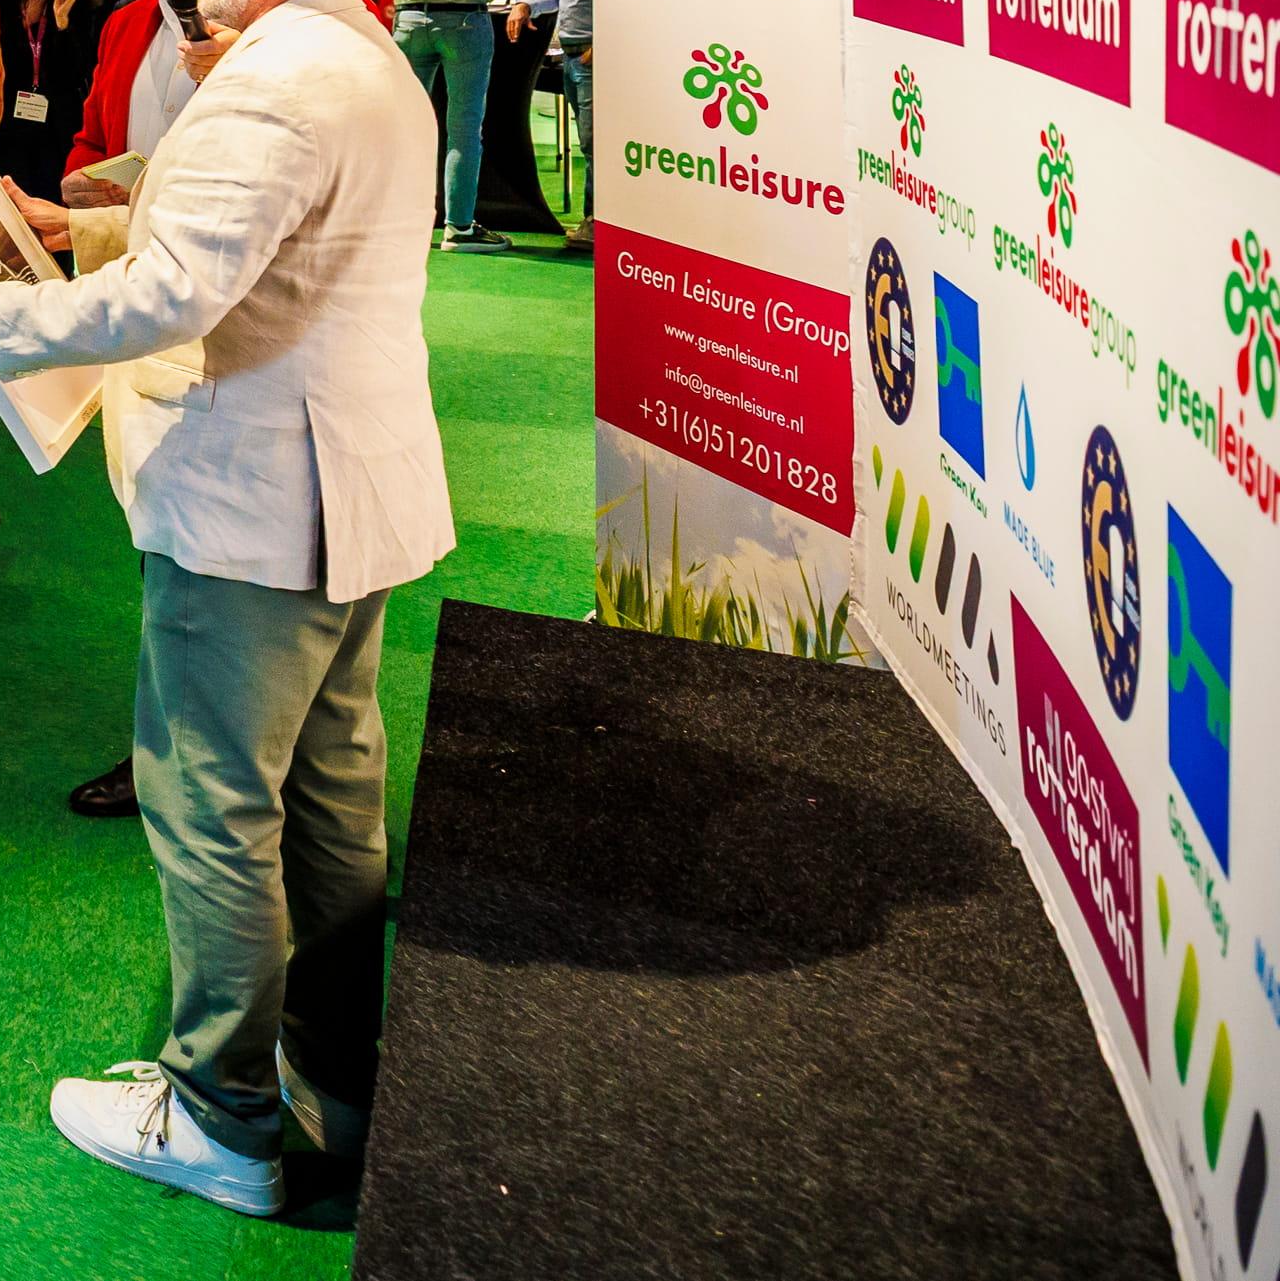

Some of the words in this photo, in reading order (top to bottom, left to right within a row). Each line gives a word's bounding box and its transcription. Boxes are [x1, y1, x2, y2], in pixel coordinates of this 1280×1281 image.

[624, 140, 846, 216] greenleisure
[617, 251, 676, 294] Green
[682, 271, 757, 320] Leisure
[764, 297, 850, 357] (Group
[664, 322, 799, 384] www.greenleisure.nl
[993, 223, 1138, 390] greenleisuregroup
[639, 397, 838, 505] +31(6)51201828
[664, 363, 805, 435] info@greenleisure.nl
[1003, 500, 1029, 552] MADE
[1032, 535, 1056, 589] BLUE
[886, 576, 1007, 757] WORLDMEETINGS
[1026, 725, 1140, 1000] rotterdam
[1064, 731, 1135, 923] gastvrij
